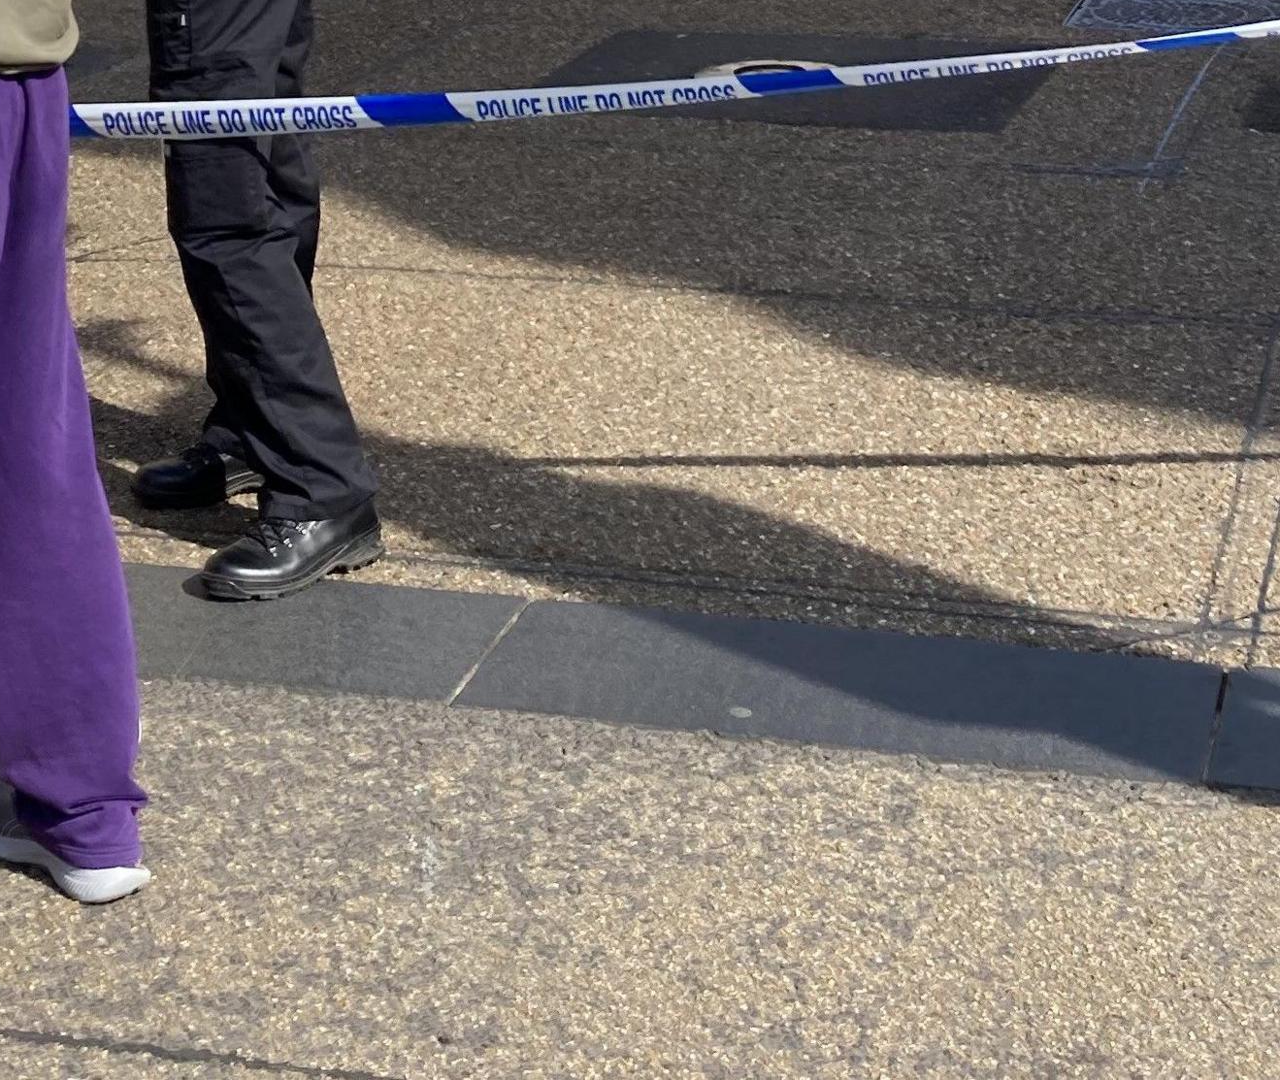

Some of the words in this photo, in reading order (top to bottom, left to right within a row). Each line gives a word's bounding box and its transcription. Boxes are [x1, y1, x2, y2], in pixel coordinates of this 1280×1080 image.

[863, 68, 931, 86] POLICE
[476, 97, 542, 120] POLICE
[548, 95, 590, 115] LINE
[595, 92, 620, 111] DO
[627, 89, 665, 108] NOT
[101, 111, 170, 136] POLICE
[171, 110, 216, 135] LINE
[219, 109, 245, 134] DO
[248, 107, 286, 133] NOT
[292, 105, 358, 131] CROSS
